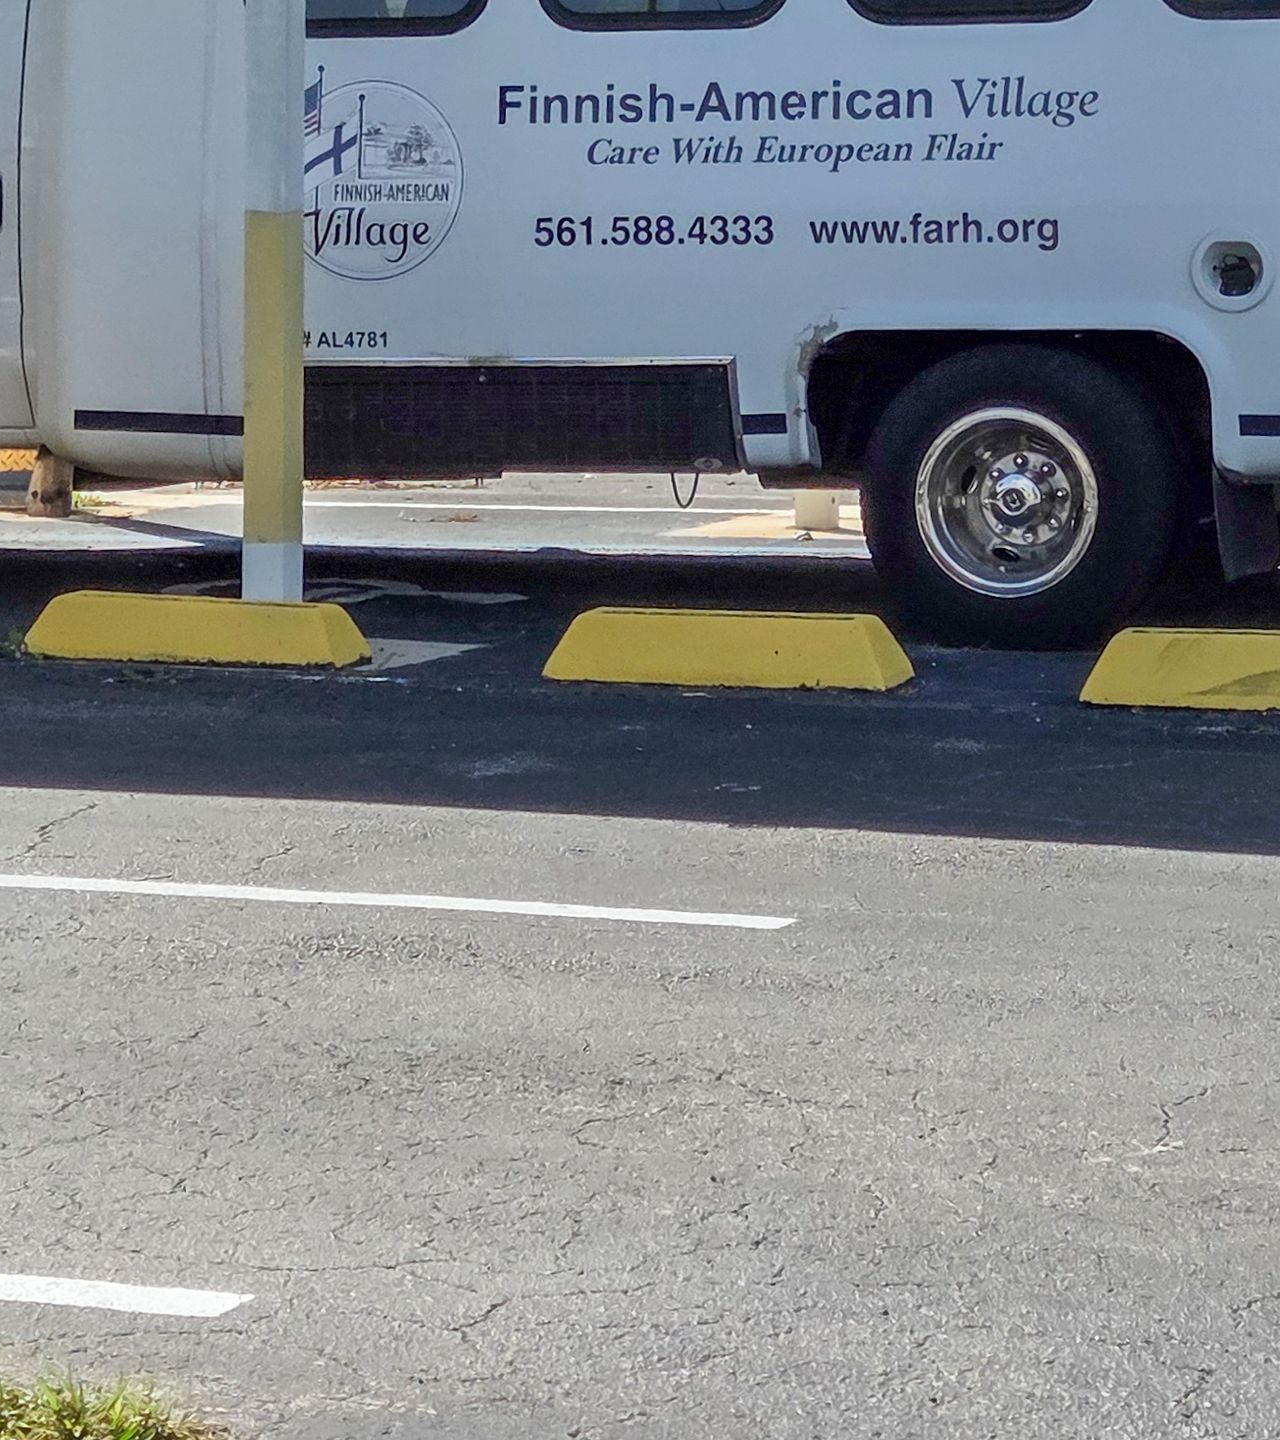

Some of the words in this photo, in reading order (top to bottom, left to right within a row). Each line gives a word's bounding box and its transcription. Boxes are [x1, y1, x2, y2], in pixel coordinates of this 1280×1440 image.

[497, 79, 933, 125] Finnish-American
[951, 74, 1100, 126] Village
[586, 137, 660, 166] Care
[671, 135, 744, 166] With
[751, 135, 913, 174] European
[920, 131, 1005, 162] Flair
[333, 183, 450, 202] FINNISH-AMERICAN
[304, 207, 431, 263] Village
[533, 214, 775, 248] 561.588.4333
[808, 211, 1059, 252] www.farh.org
[317, 330, 388, 349] AL4781
